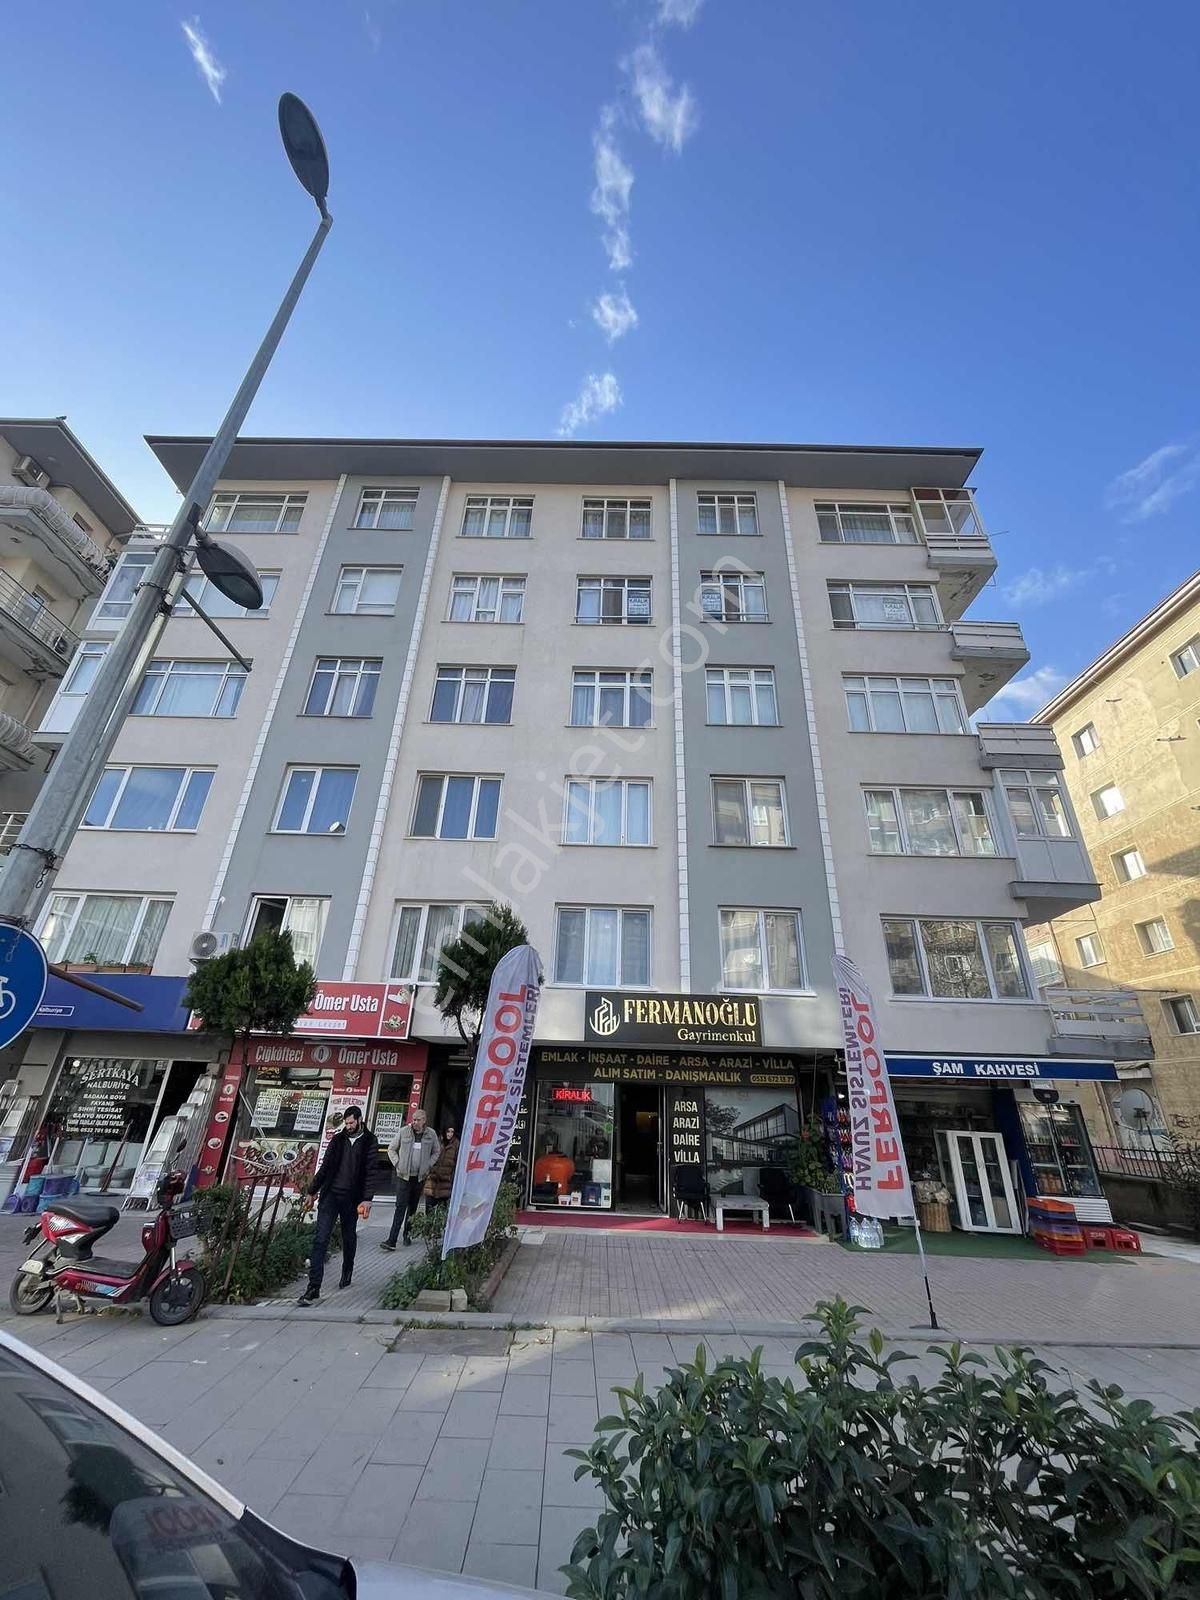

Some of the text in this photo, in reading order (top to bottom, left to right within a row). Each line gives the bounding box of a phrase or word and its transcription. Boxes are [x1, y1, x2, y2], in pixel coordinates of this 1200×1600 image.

[314, 990, 379, 1012] Ömer Usta
[623, 998, 757, 1026] FERMANOĞLU
[677, 1029, 756, 1044] Gayrimenkul
[255, 1045, 305, 1063] Çiğköfteci
[371, 1050, 399, 1066] Usta
[541, 1051, 794, 1070] EMLAK İNŞAAT DAİRE ARSA ARAZİ VİLLA
[80, 1067, 139, 1086] SERTKAYA
[594, 1067, 742, 1082] ALIM SATIM DANIŞMANLIK
[932, 1062, 1041, 1076] ŞAM KAHVESİ
[87, 1080, 131, 1090] NALBURİYE
[466, 984, 528, 1173] FERPOOL
[555, 1088, 592, 1101] KİRALIK
[674, 1100, 698, 1112] ARSA
[672, 1116, 700, 1129] ARAZİ
[488, 1103, 517, 1172] HAVUZ
[673, 1132, 700, 1146] DAİRE
[673, 1149, 700, 1163] VİLLA
